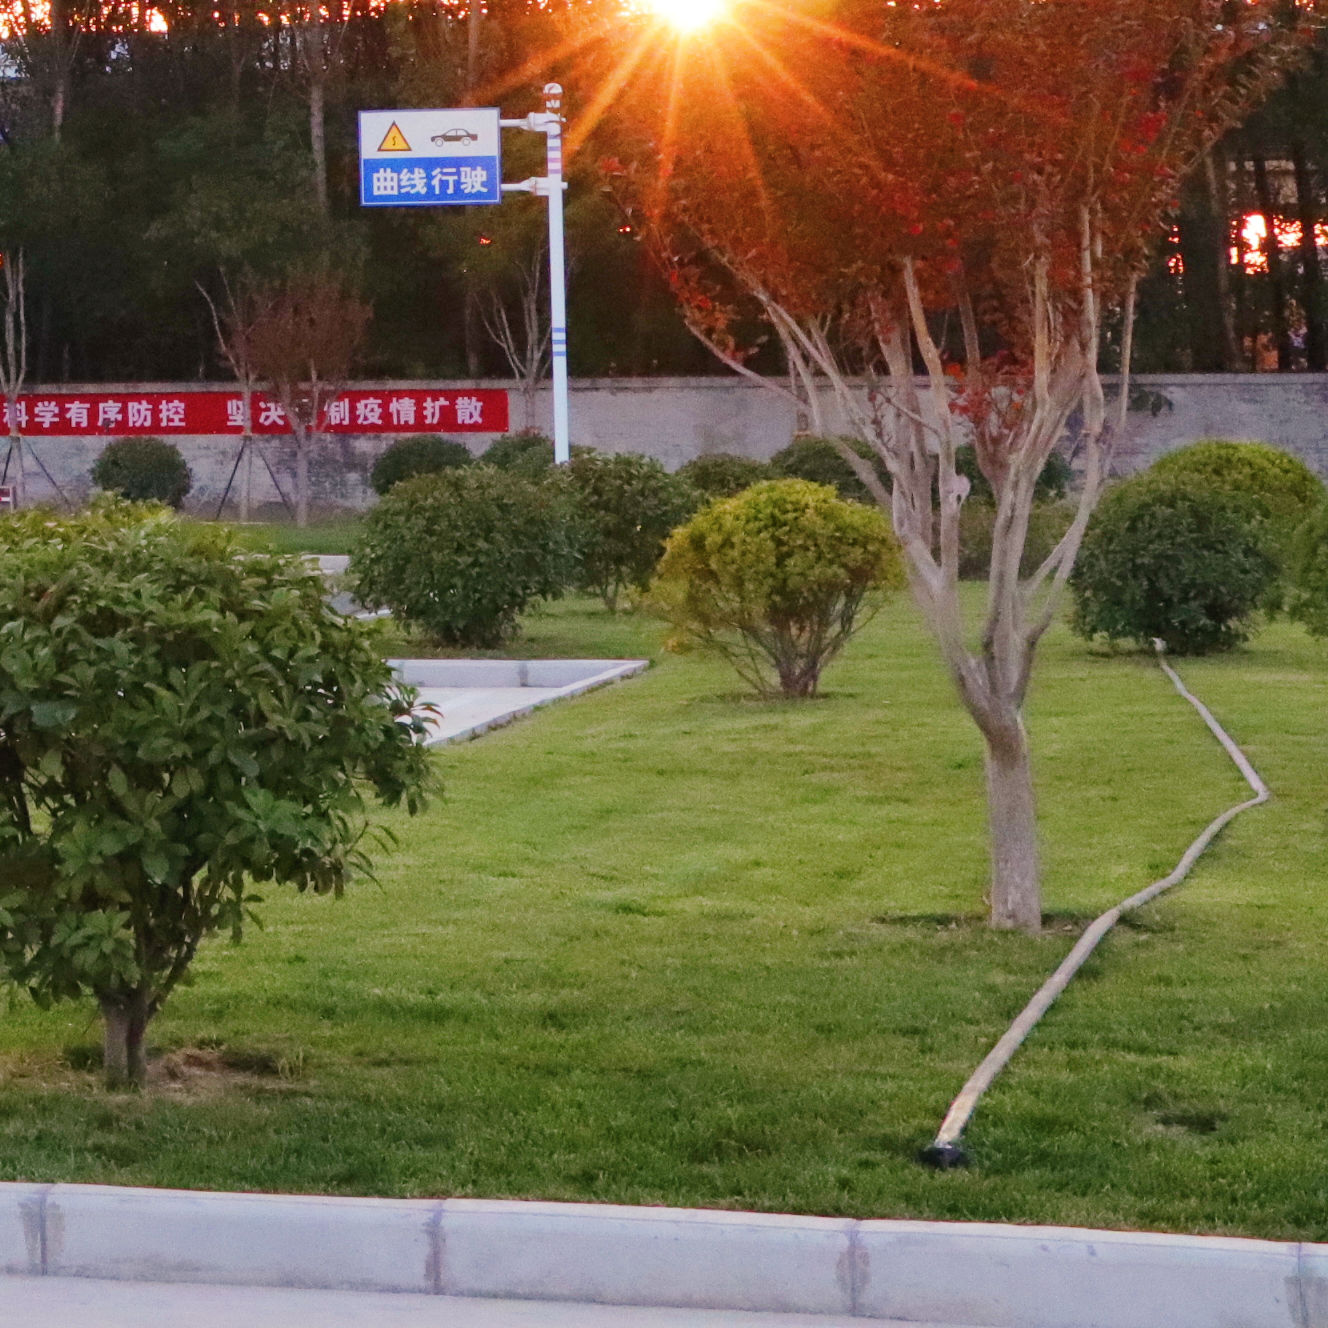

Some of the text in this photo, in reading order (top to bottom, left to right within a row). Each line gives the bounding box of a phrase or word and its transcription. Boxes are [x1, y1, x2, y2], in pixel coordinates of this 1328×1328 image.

[372, 166, 488, 195] 曲线行驶
[227, 396, 483, 426] 坚决制疫情扩散
